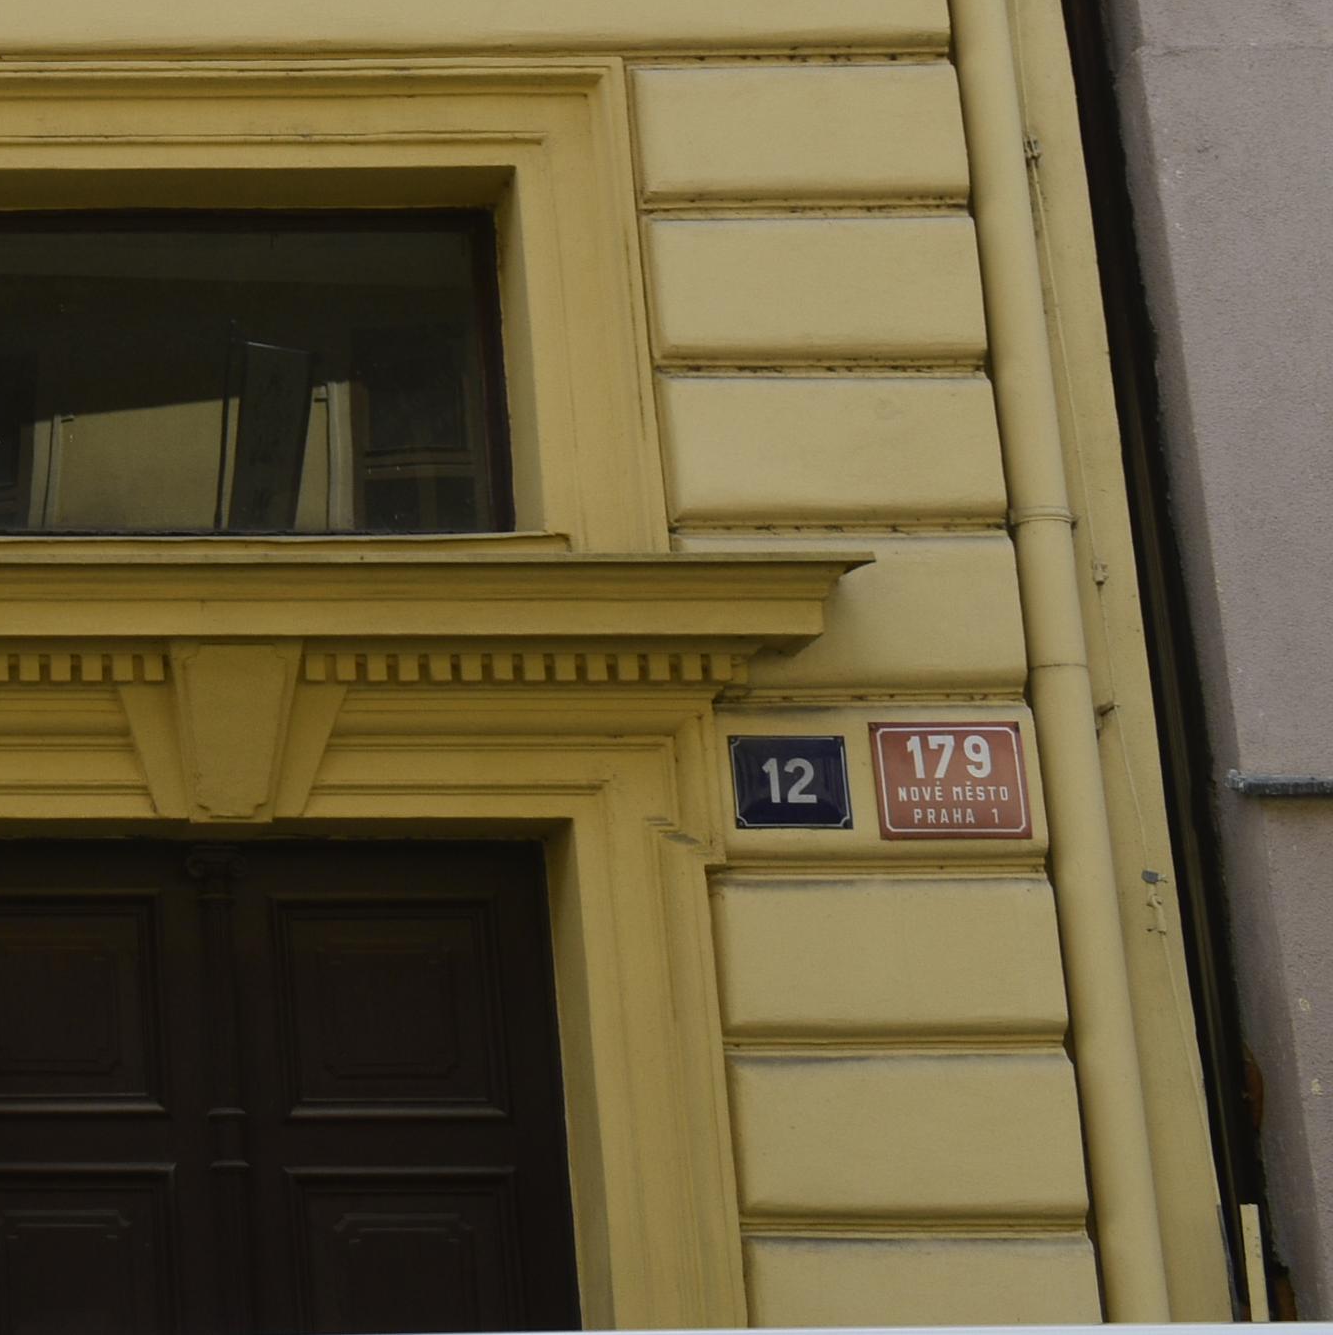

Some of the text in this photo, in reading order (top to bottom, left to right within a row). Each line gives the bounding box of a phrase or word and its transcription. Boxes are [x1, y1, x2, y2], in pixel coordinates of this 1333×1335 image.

[906, 734, 992, 780] 179
[761, 757, 818, 804] 12
[897, 780, 1009, 802] NOVÉ MĚSTO
[913, 807, 1000, 824] PRAHA 1
